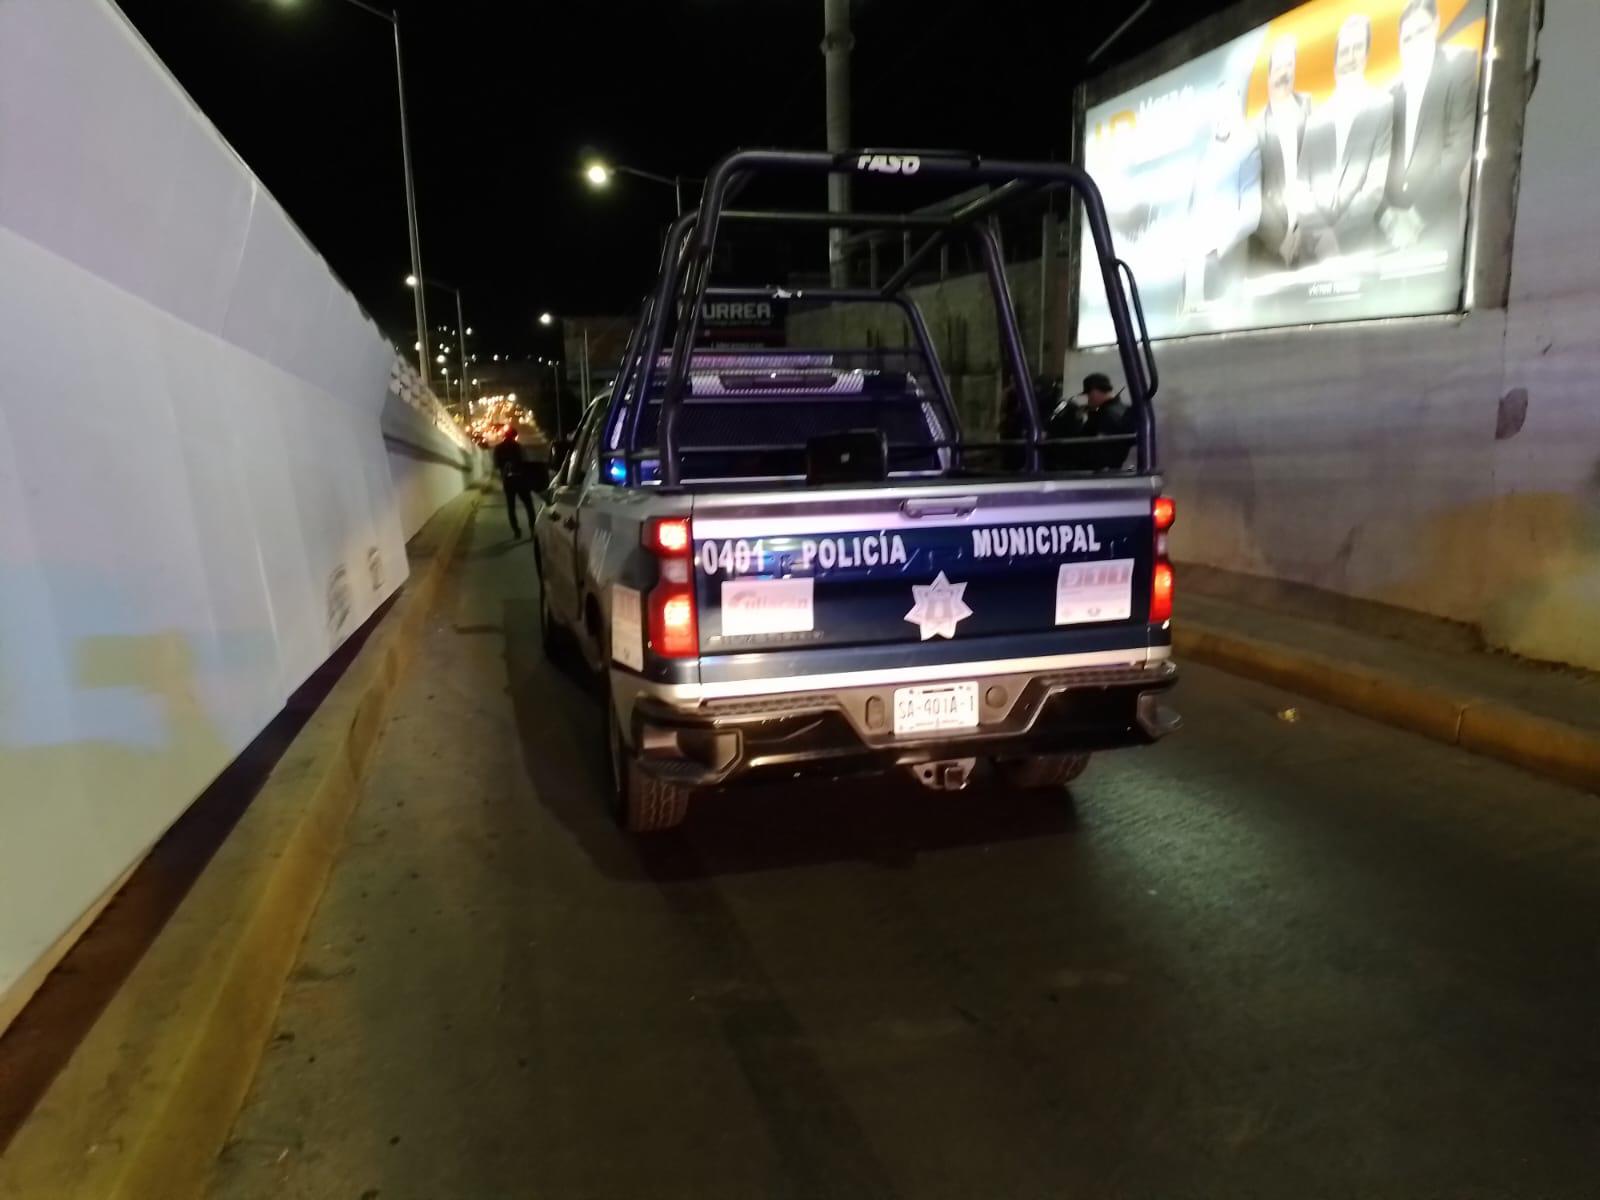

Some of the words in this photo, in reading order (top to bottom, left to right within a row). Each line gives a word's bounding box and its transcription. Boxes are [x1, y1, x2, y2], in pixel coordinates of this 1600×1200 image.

[702, 303, 771, 319] URREA
[802, 529, 907, 569] POLICÍA
[972, 524, 1101, 558] MUNICIPAL
